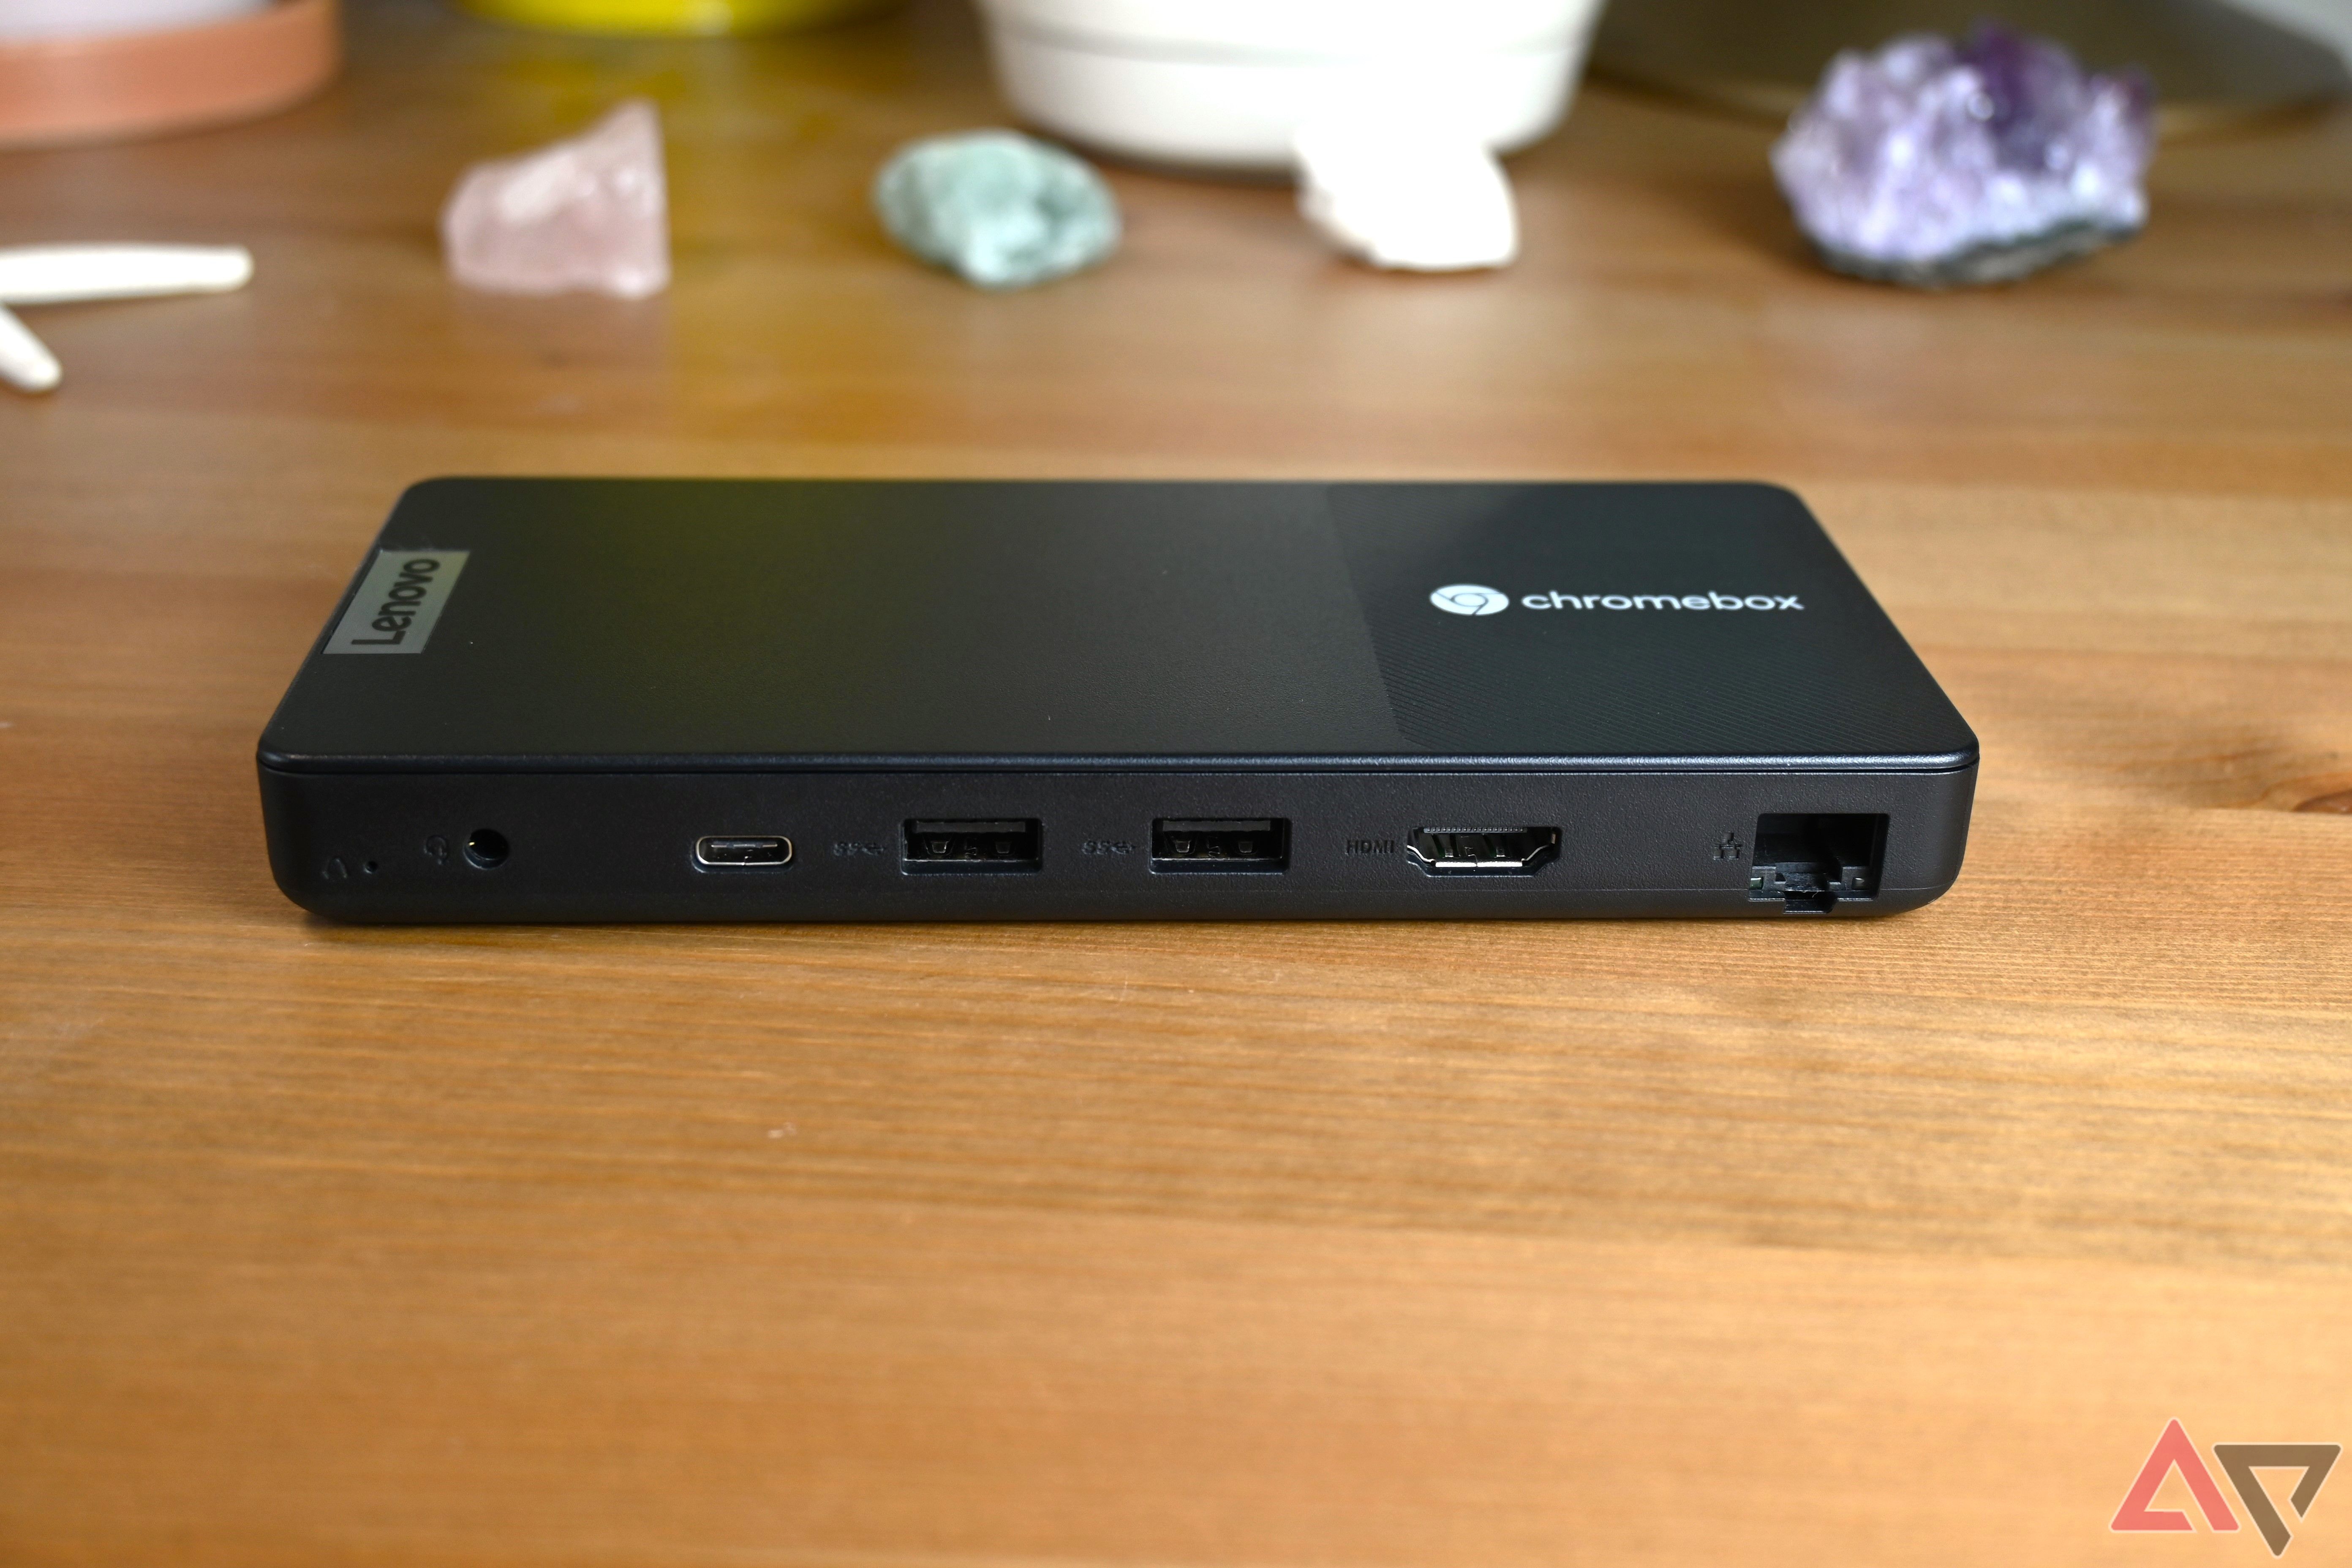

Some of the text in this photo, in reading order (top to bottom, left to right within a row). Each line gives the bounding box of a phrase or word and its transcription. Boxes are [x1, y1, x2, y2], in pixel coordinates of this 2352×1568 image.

[351, 558, 440, 645] Lenovo
[1521, 591, 1804, 610] chromebox
[1347, 840, 1394, 854] HDMI
